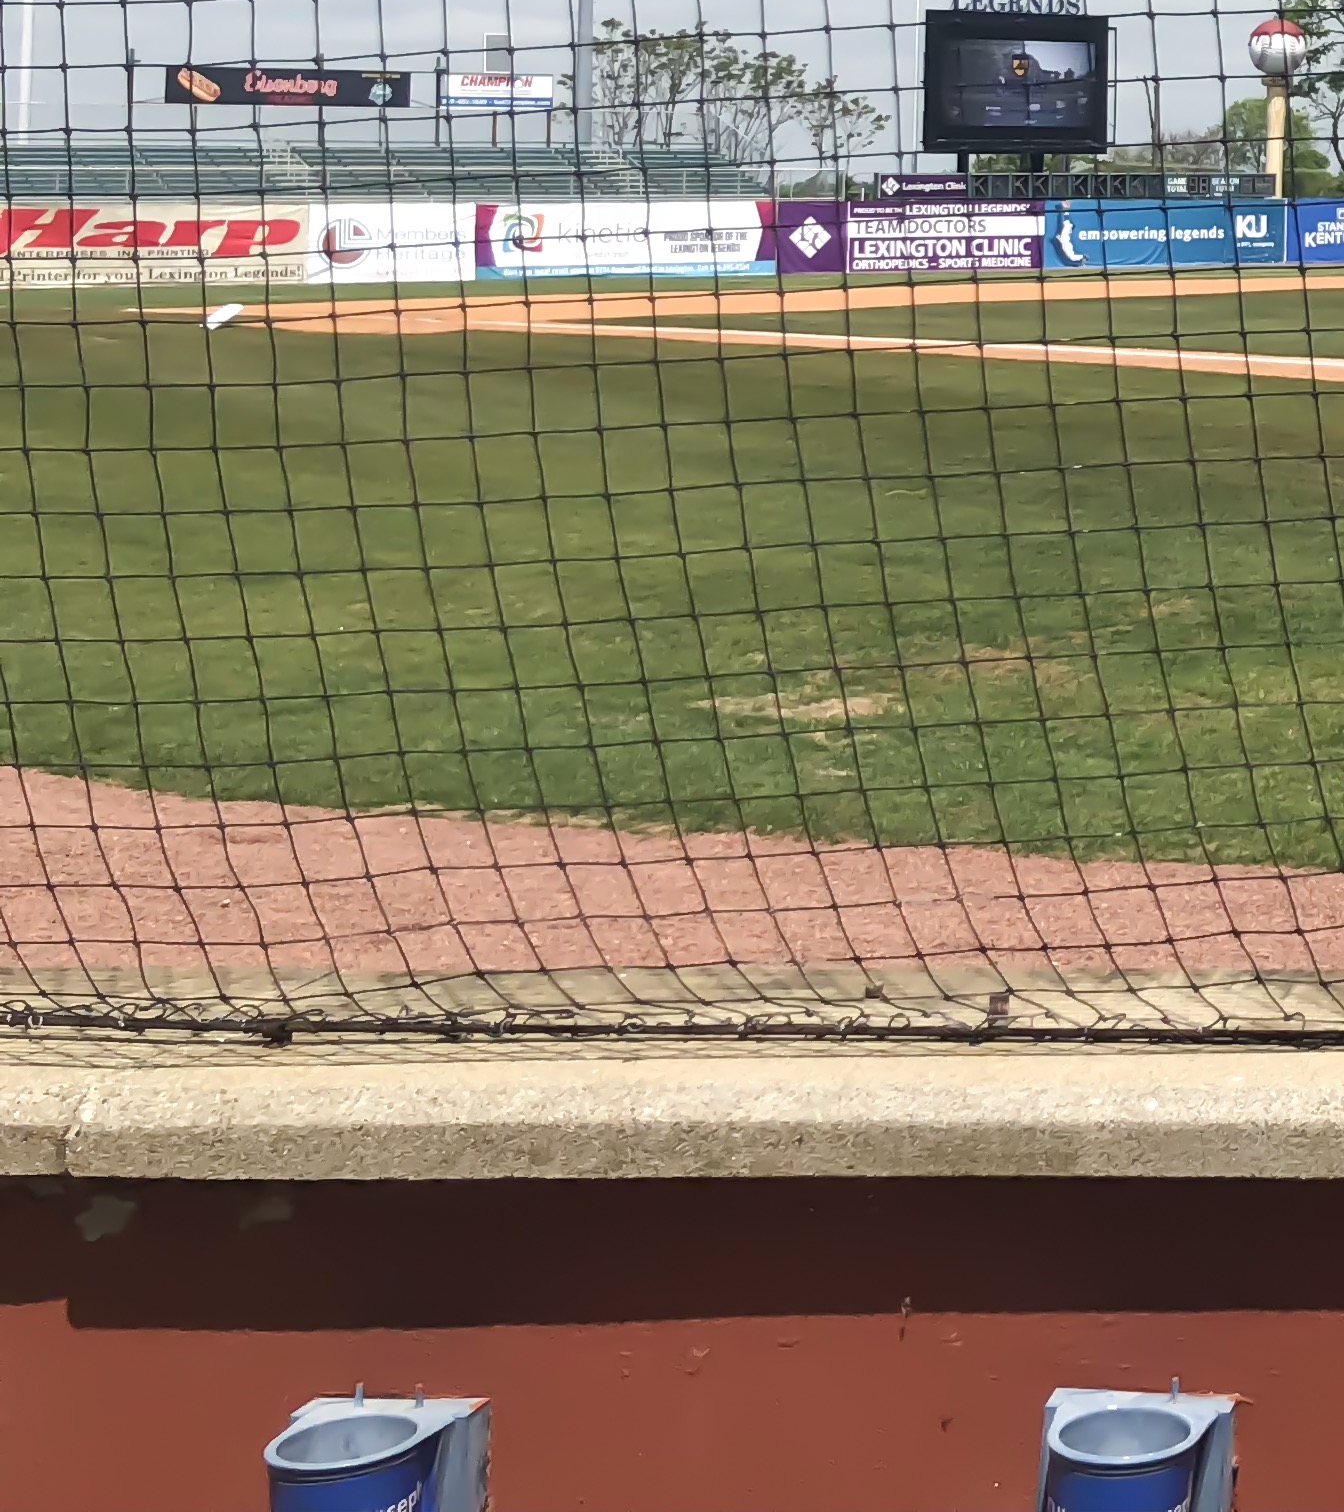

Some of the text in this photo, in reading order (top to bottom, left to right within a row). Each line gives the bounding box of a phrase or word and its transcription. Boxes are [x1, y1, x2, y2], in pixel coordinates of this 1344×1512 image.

[0, 208, 301, 257] Harp
[856, 219, 987, 235] TEAM DOCTORS
[1078, 224, 1225, 243] empowering legends
[1236, 214, 1268, 238] KU
[377, 228, 467, 241] Members
[690, 231, 724, 242] SPONOR
[376, 248, 467, 263] Heritage
[853, 237, 1032, 259] LEXINGTON CLINIC
[852, 256, 1032, 270] ORTHOPEDICS SPORTS MEDICINE
[12, 268, 71, 283] Printer
[75, 267, 99, 282] for
